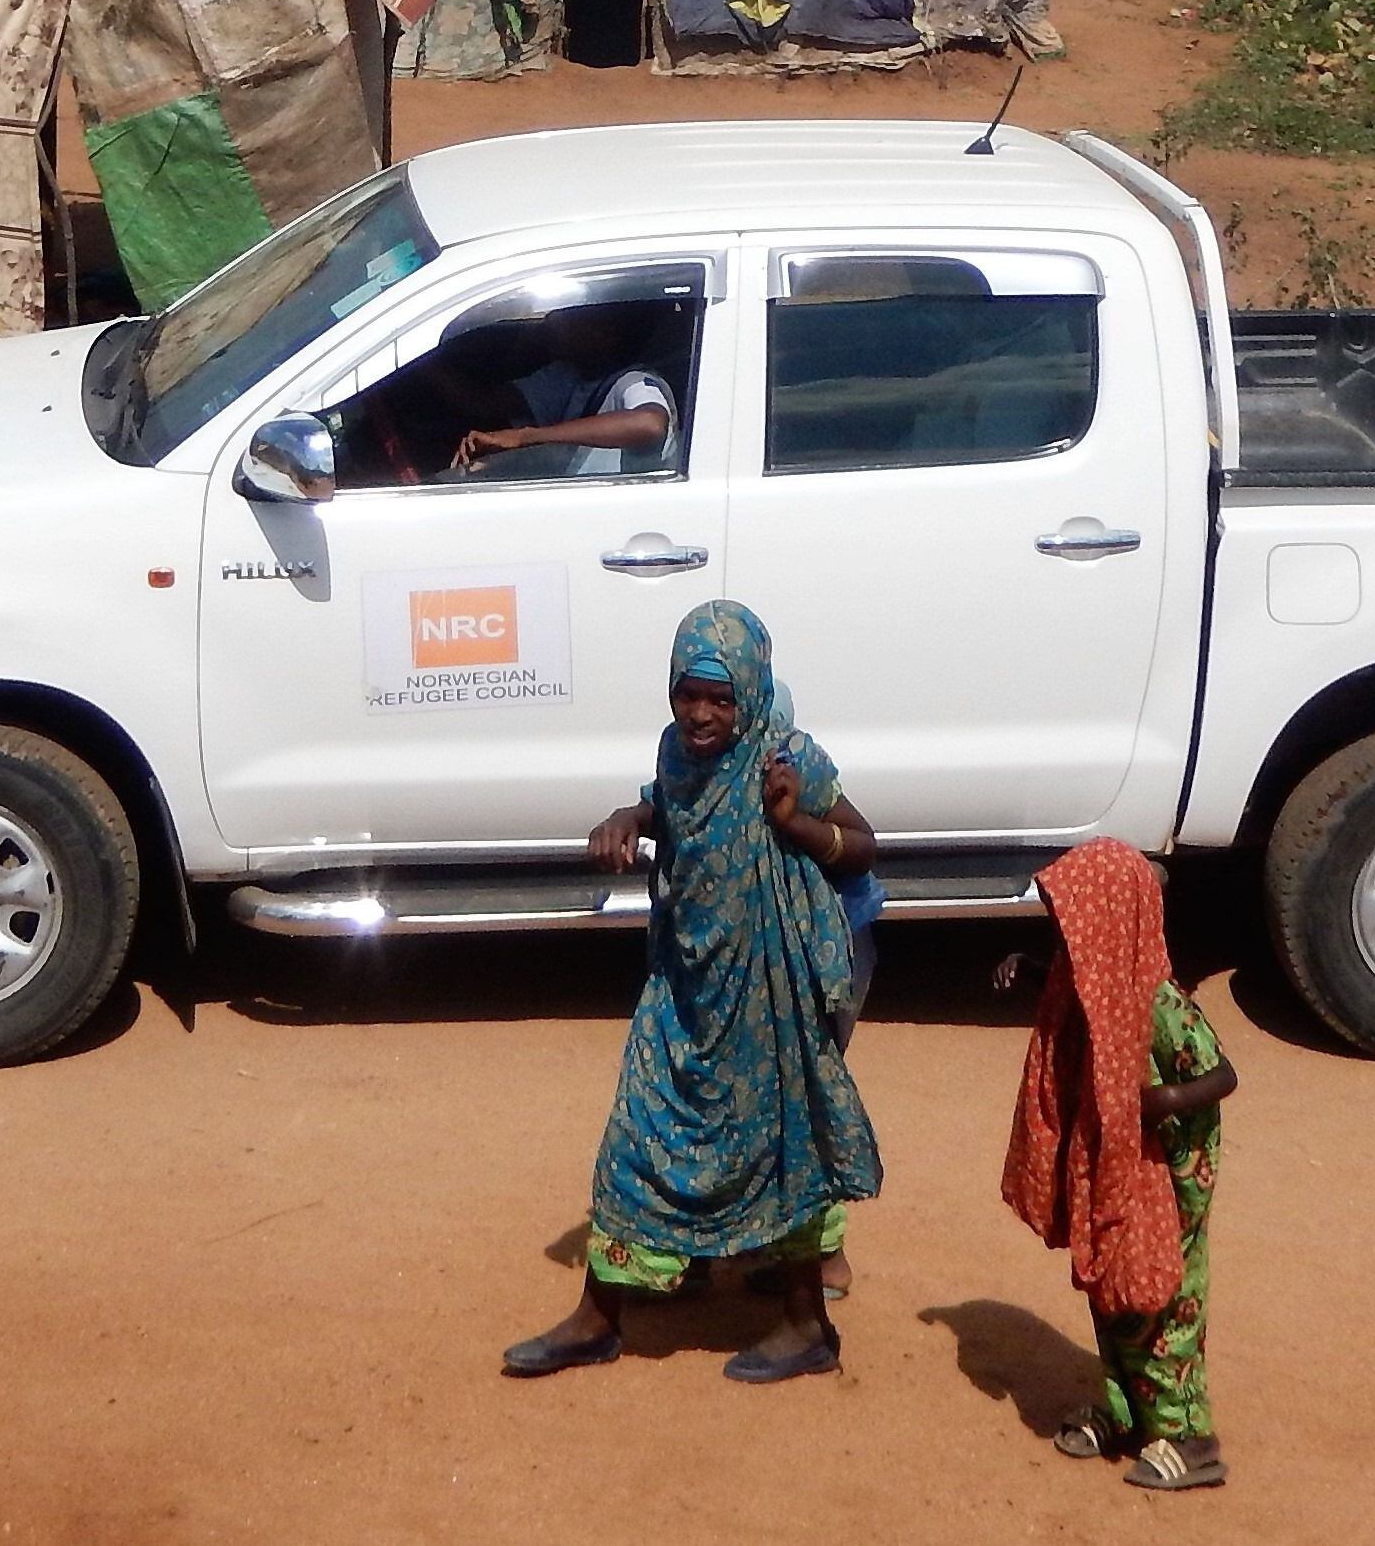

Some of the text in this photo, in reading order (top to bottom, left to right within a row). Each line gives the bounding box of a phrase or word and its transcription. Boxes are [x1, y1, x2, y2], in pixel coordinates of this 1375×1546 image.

[222, 560, 316, 580] HILUX
[422, 613, 506, 641] NRC
[406, 669, 537, 688] NORWEGIAN
[475, 683, 569, 700] COUNCIL
